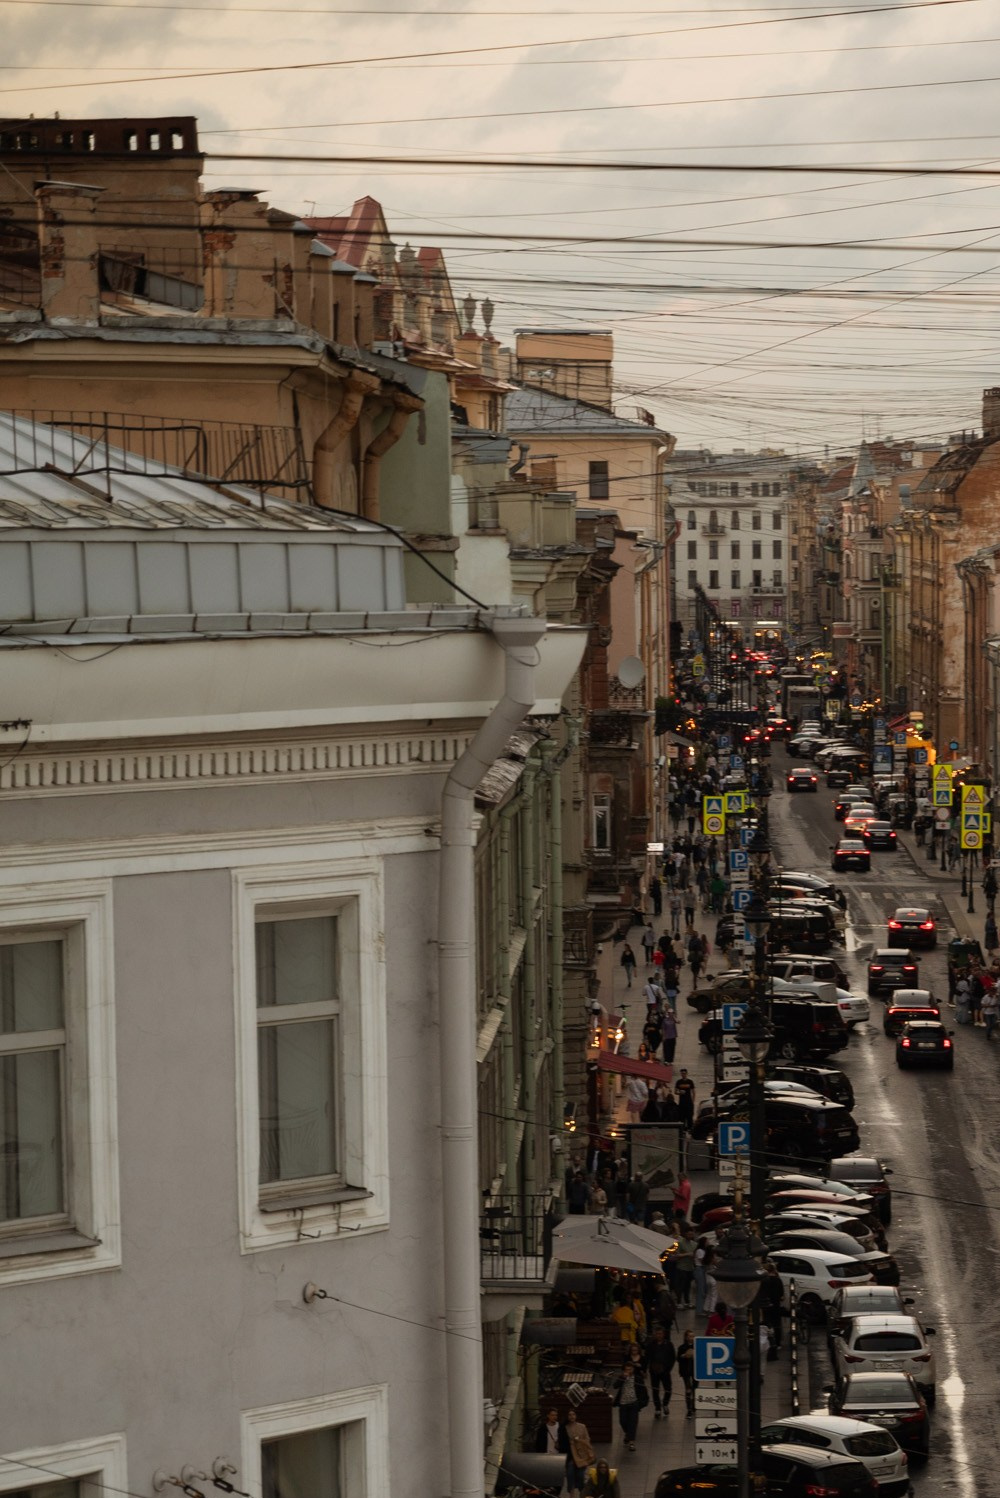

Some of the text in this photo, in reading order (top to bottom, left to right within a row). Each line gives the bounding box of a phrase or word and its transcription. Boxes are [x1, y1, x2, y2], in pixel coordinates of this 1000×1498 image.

[720, 736, 728, 746] P
[897, 733, 905, 742] P
[734, 756, 742, 765] P
[918, 751, 927, 760] P
[710, 820, 720, 828] 40
[745, 830, 755, 843] P
[734, 853, 745, 867] P
[738, 893, 751, 908] P
[729, 1007, 745, 1027] P
[727, 1126, 746, 1151] P
[706, 1342, 730, 1376] P
[711, 1449, 721, 1457] 10
